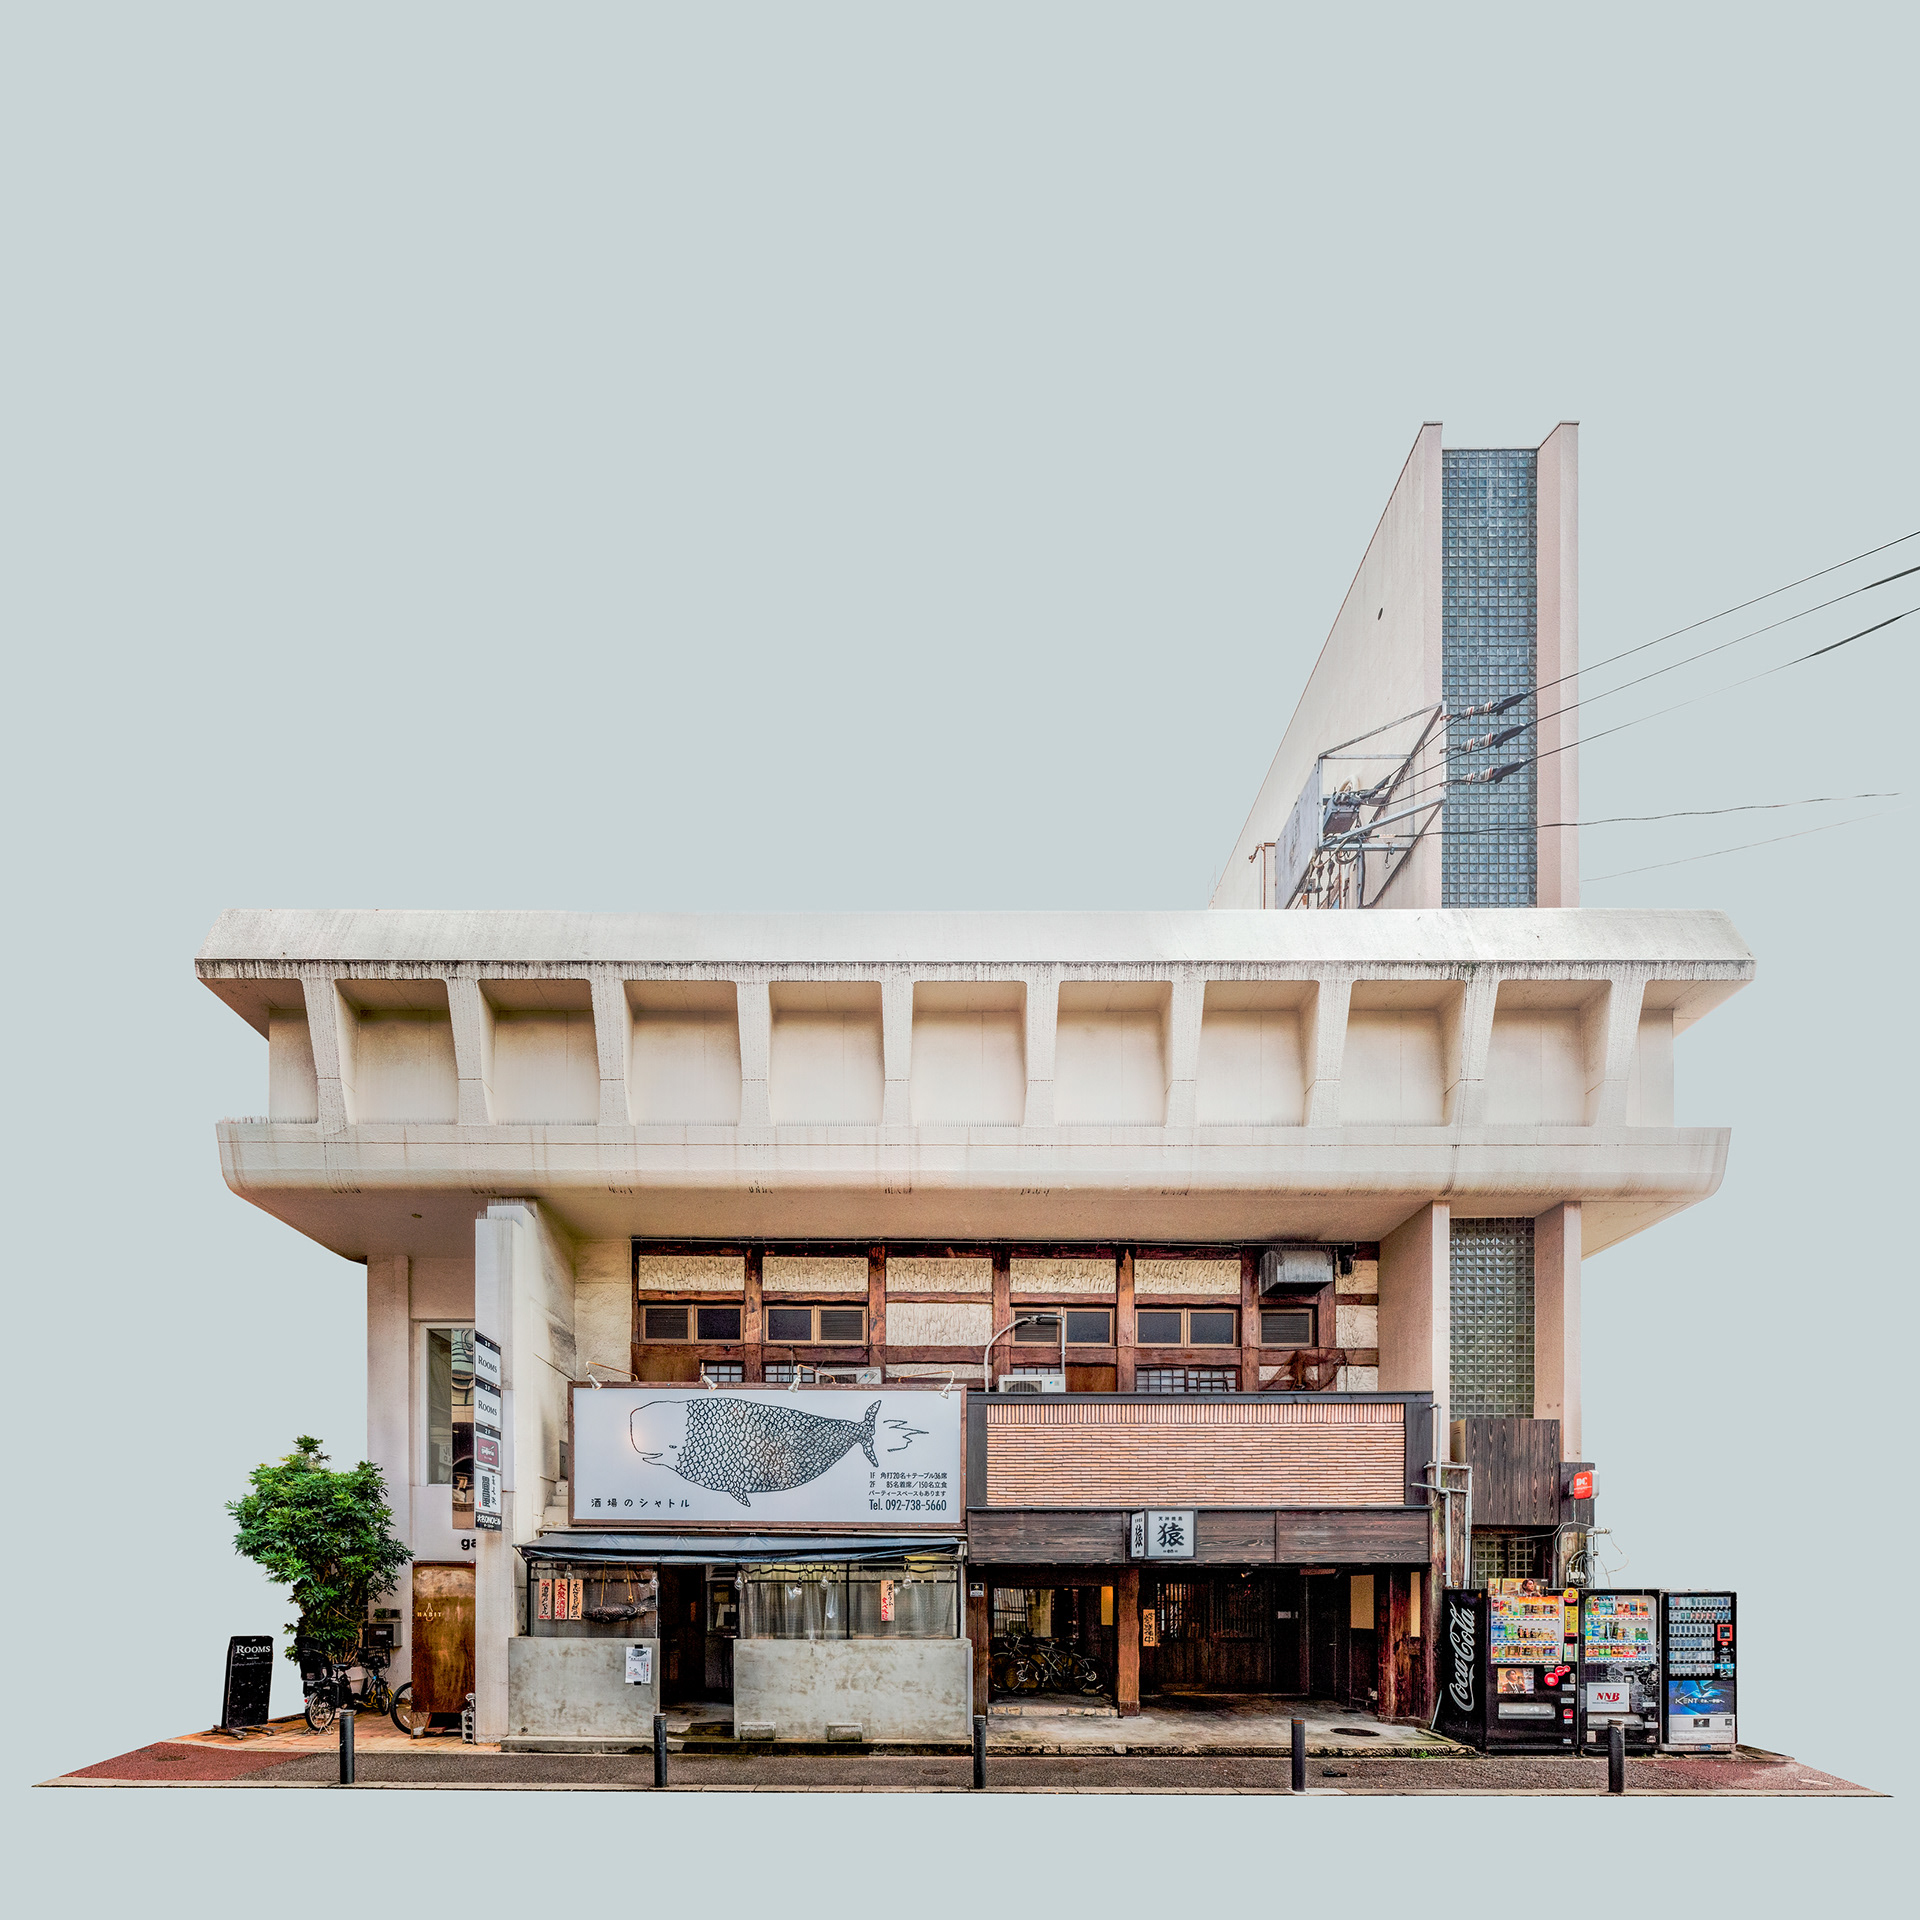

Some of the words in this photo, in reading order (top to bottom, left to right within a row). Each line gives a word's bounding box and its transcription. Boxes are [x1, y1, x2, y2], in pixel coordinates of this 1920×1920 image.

[591, 1498, 690, 1509] 酒場のシャトル
[869, 1498, 884, 1511] Tel.
[885, 1499, 948, 1512] 092-738-5660
[1157, 1522, 1185, 1548] 猿
[1449, 1601, 1476, 1712] Coca-Cola
[1597, 1692, 1620, 1702] NNB
